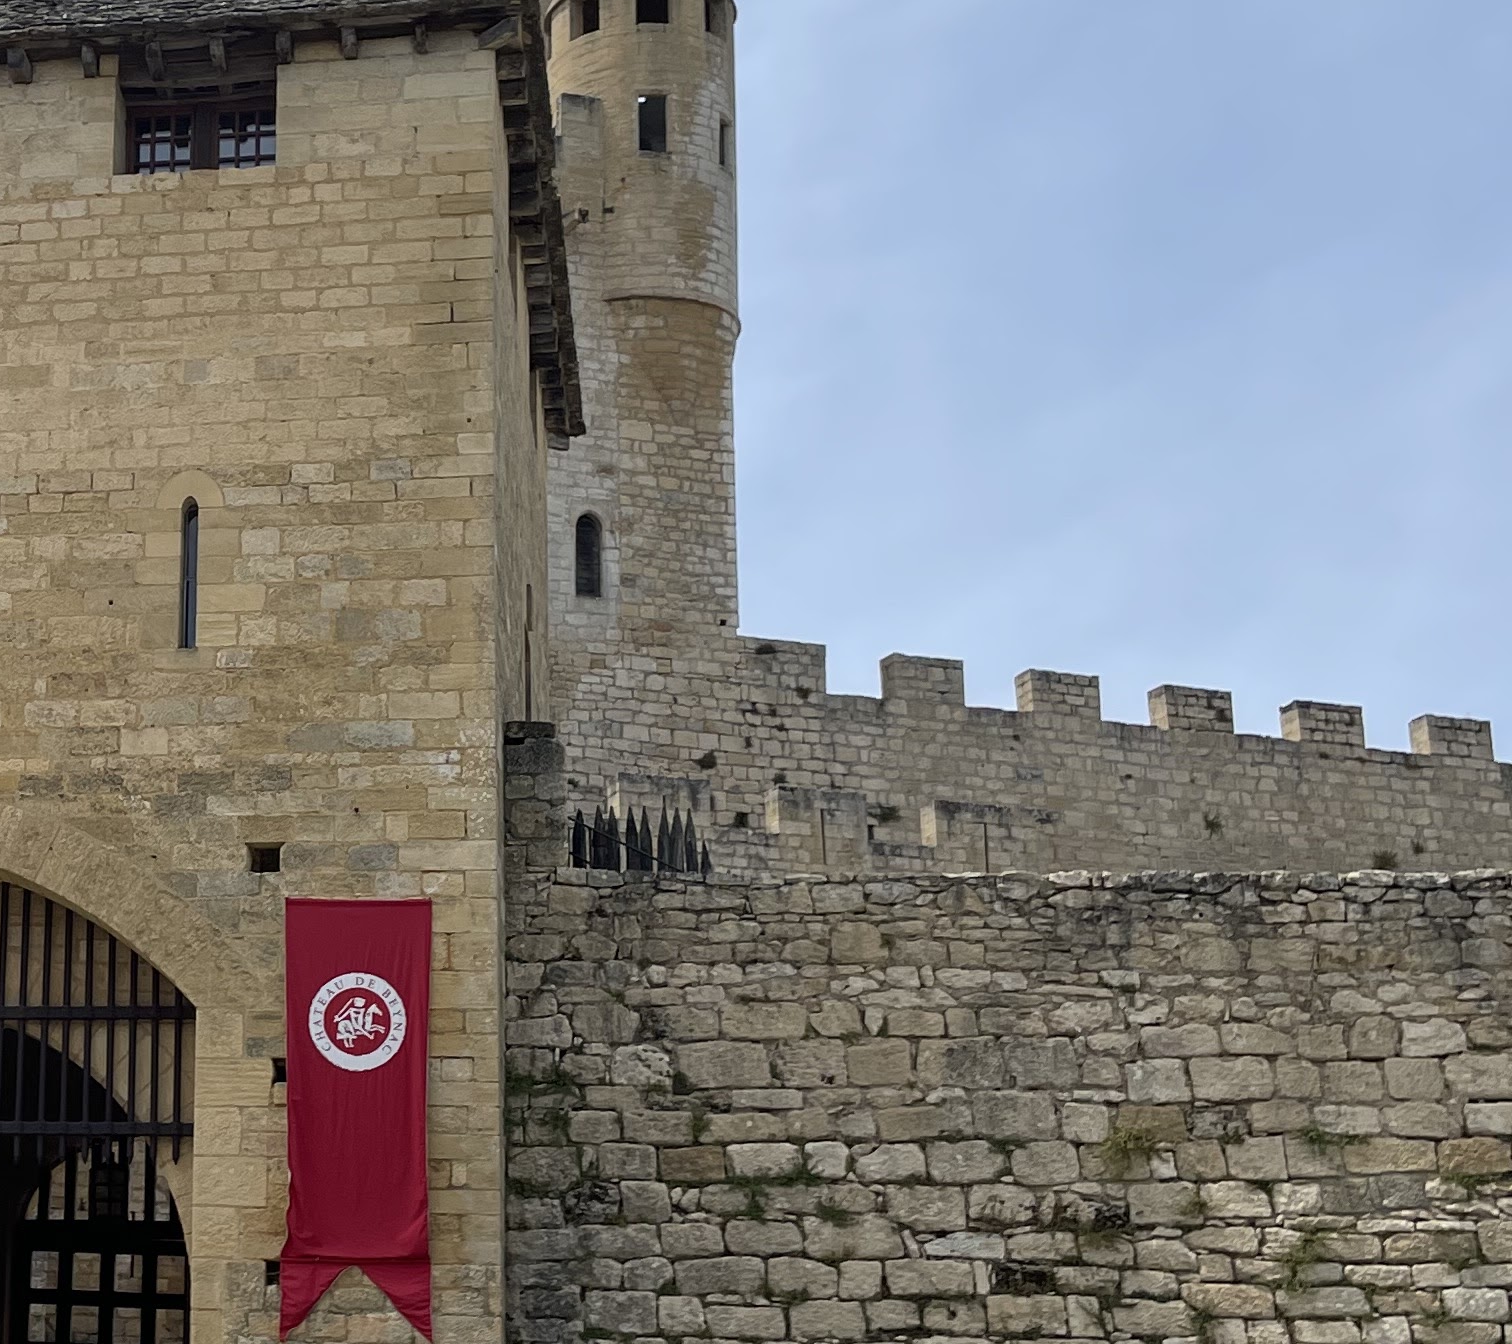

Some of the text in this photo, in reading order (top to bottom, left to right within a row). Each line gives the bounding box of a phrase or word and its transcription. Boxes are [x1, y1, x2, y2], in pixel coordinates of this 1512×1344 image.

[313, 976, 404, 1055] CHATEAU DE BEYNAC
